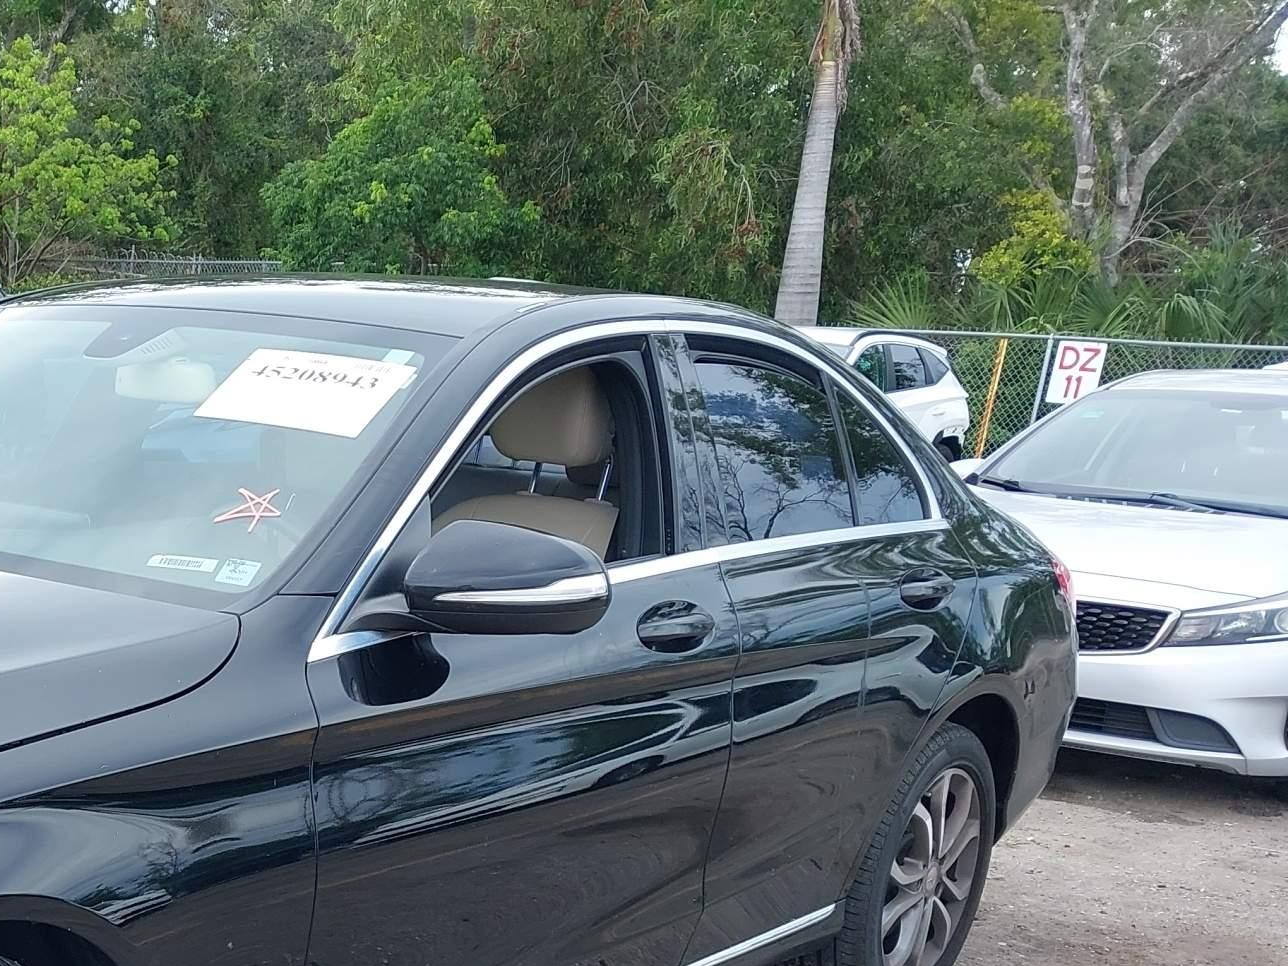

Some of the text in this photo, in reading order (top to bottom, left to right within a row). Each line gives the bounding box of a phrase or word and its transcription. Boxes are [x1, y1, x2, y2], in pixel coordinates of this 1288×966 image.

[1058, 345, 1101, 373] DZ
[251, 363, 380, 391] 45208943
[1063, 374, 1083, 400] 11
